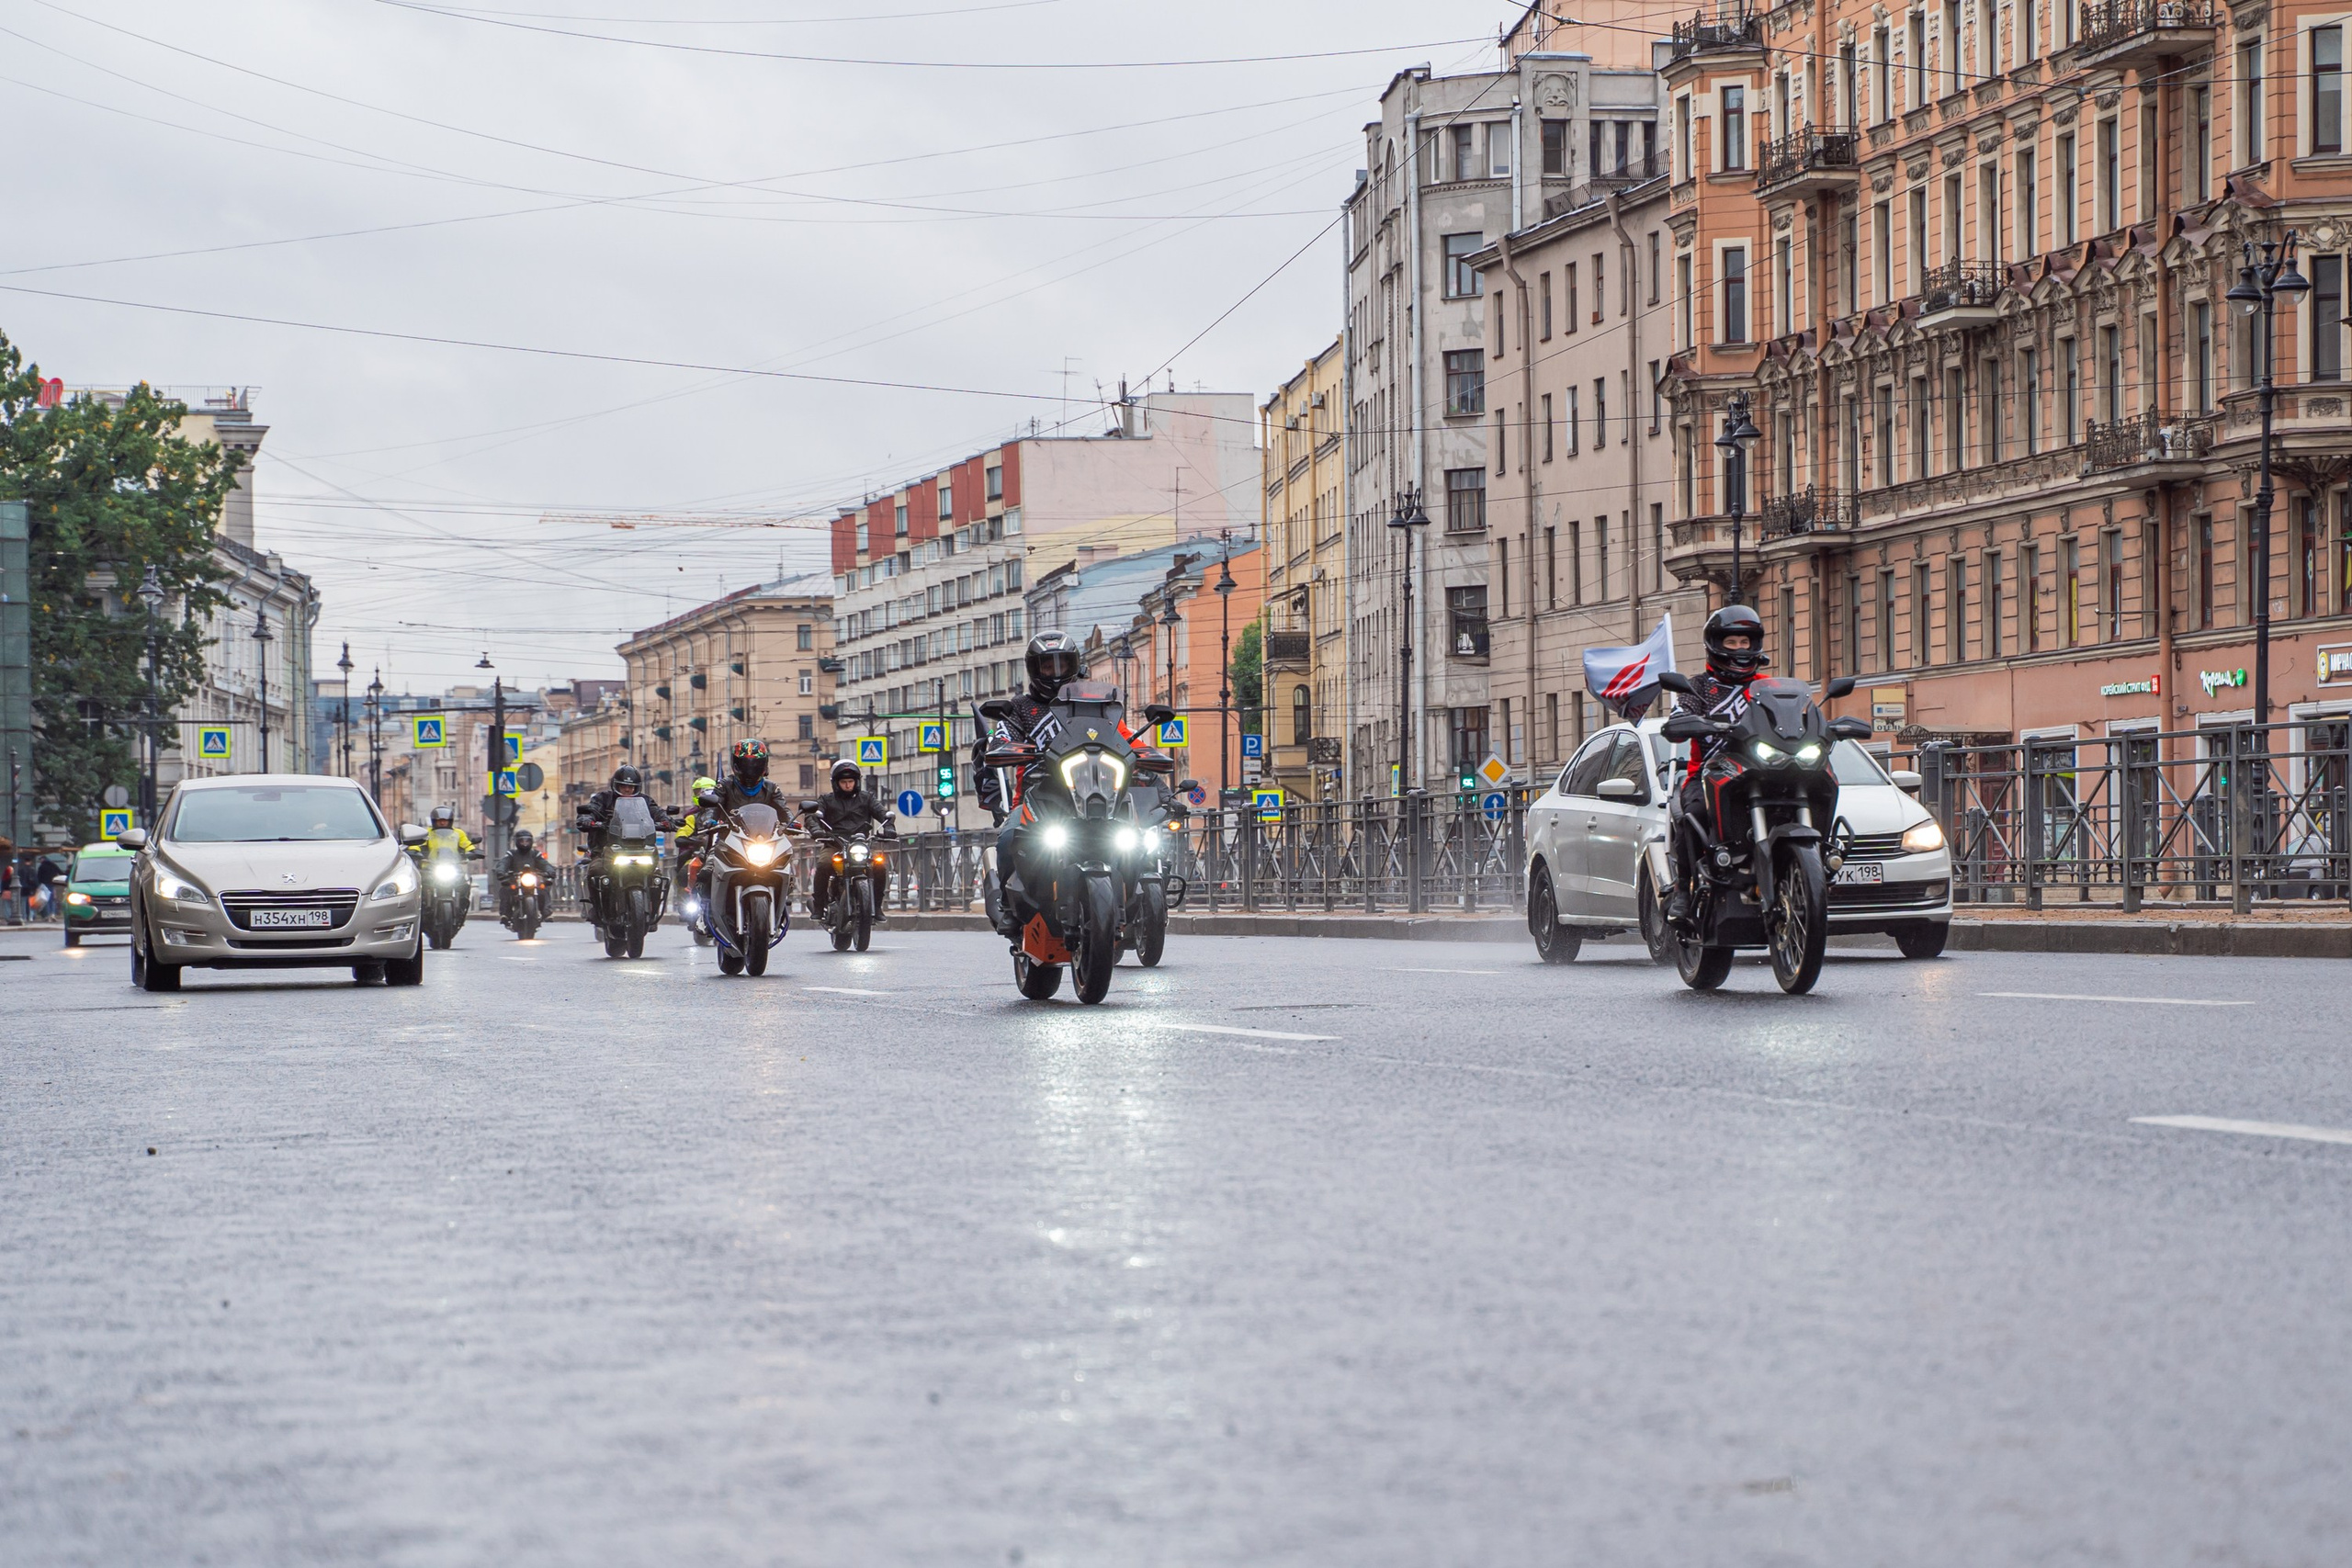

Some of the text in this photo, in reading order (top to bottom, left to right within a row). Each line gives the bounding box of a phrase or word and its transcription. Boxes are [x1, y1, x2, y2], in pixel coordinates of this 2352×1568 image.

[1858, 866, 1878, 877] 198
[254, 912, 306, 925] Н354ХН
[309, 911, 328, 920] 198
